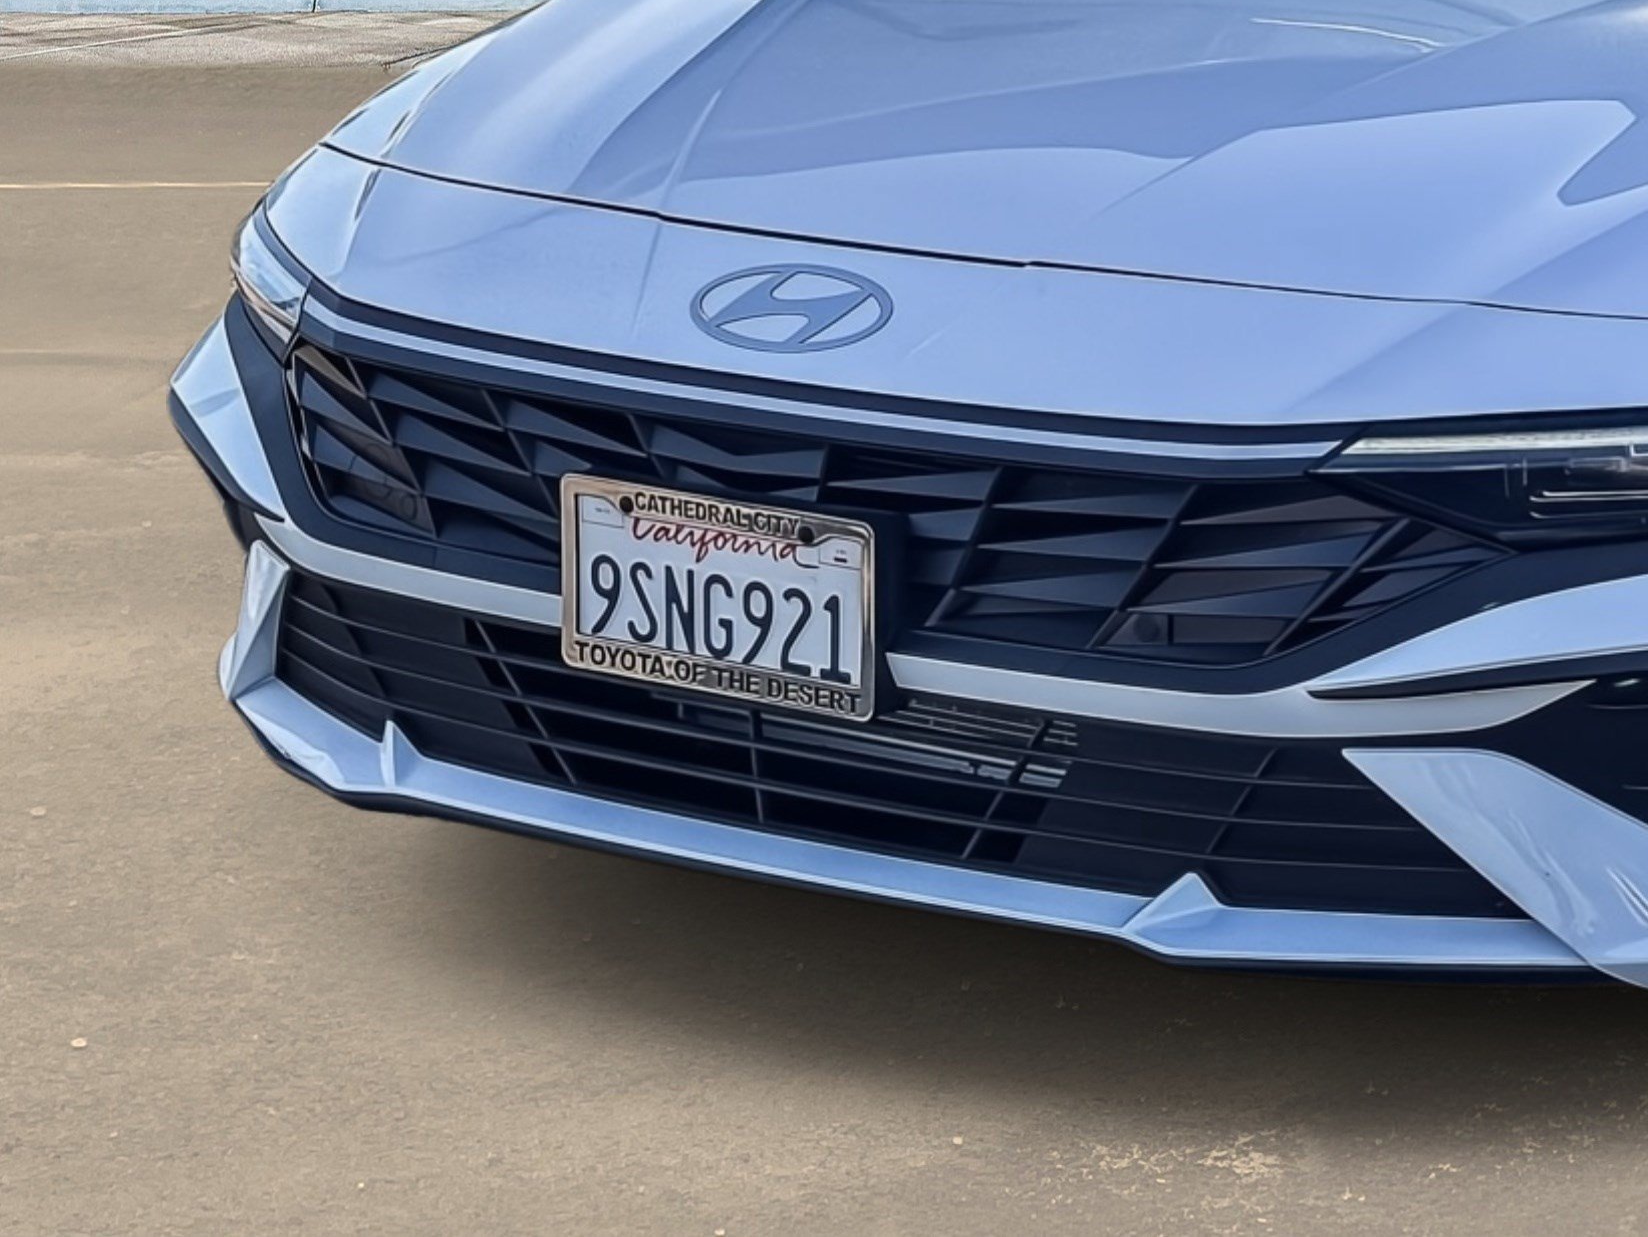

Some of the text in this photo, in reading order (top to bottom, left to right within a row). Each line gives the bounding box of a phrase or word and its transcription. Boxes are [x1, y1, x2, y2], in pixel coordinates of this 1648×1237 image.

[634, 491, 800, 536] CATHEDRAL CITY
[590, 553, 852, 685] 9SNG921
[575, 640, 862, 713] TOYOTA OF THE DESERT
